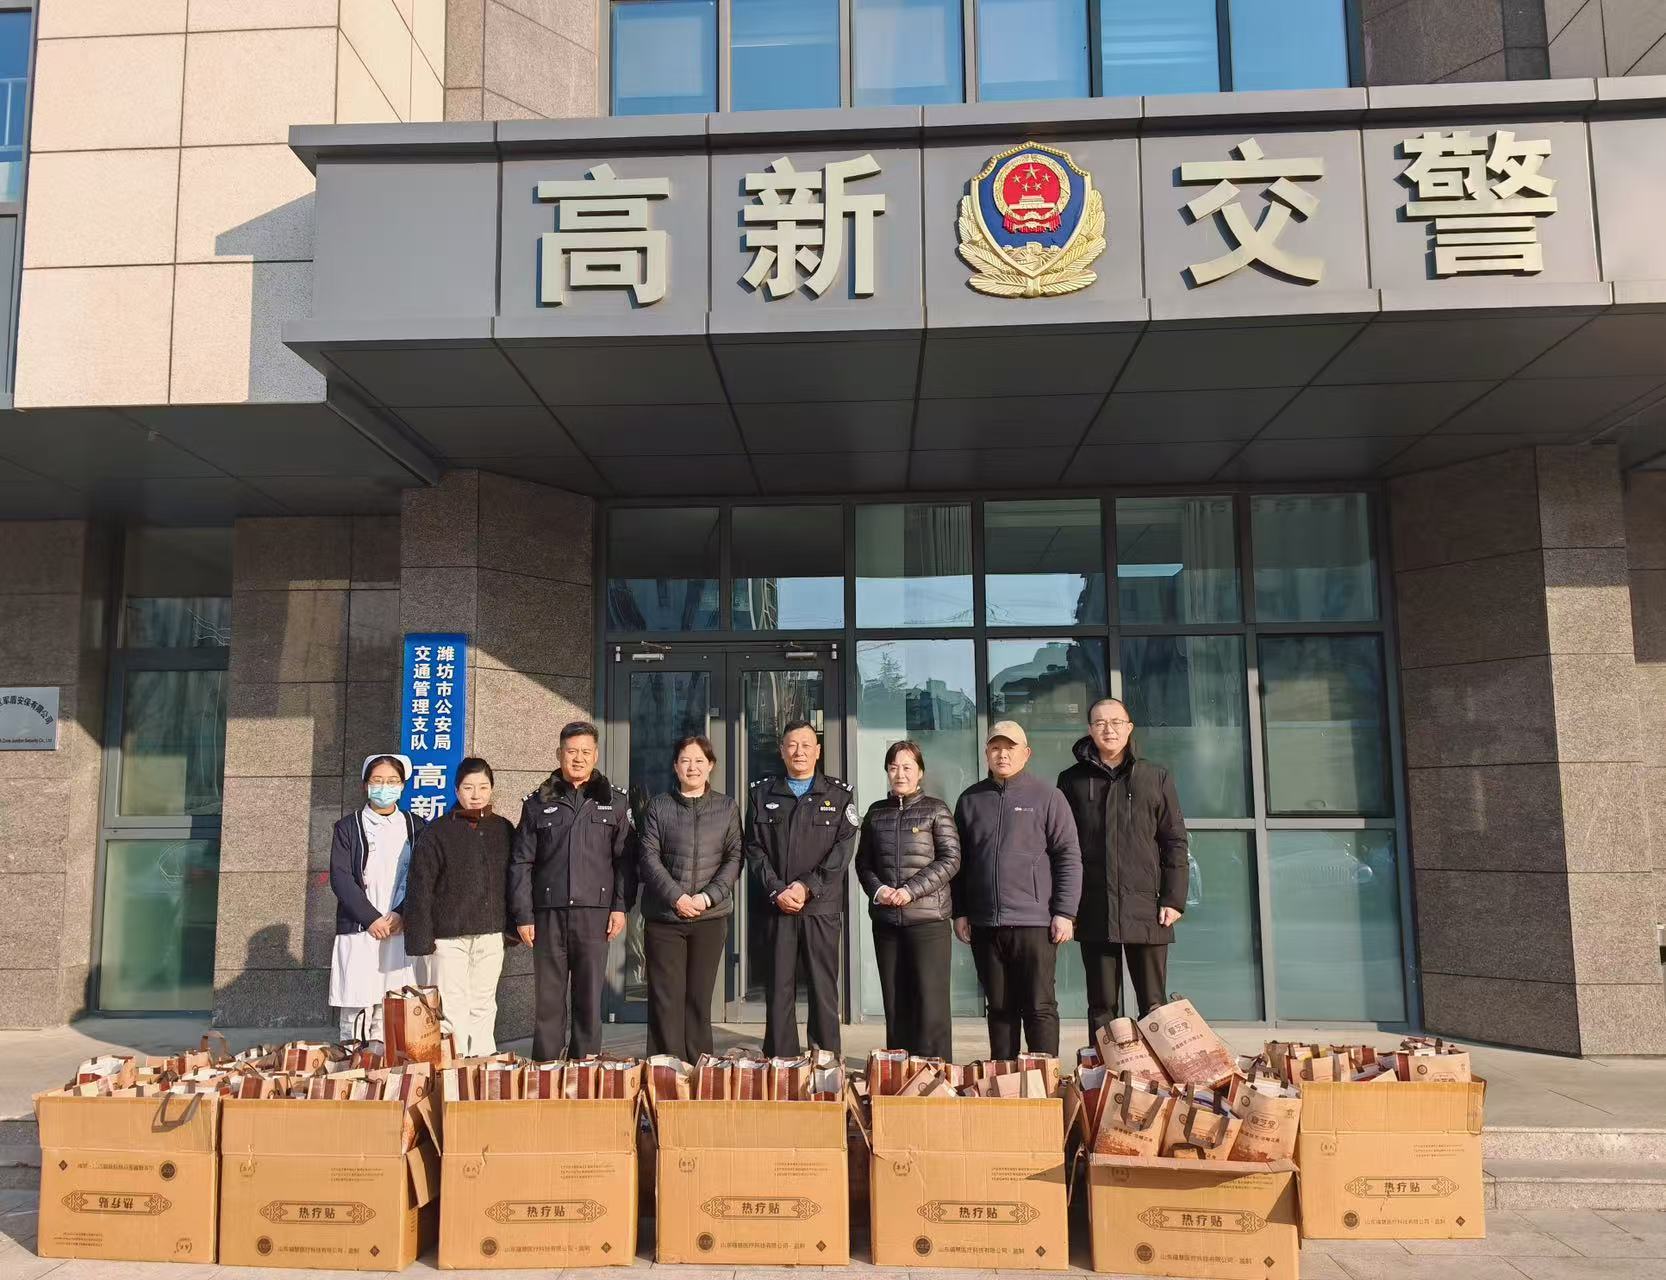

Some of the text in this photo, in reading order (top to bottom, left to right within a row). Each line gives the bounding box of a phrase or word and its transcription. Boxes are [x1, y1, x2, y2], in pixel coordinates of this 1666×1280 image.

[538, 130, 1559, 304] 高新 交警
[410, 645, 432, 751] 交通管理支队
[433, 645, 455, 751] 潍坊市公安局
[411, 762, 447, 821] 高新
[1384, 1181, 1420, 1193] 热疗贴
[299, 1207, 336, 1219] 热疗贴
[527, 1205, 565, 1217] 热疗贴
[742, 1202, 780, 1215] 热疗贴
[959, 1206, 998, 1219] 热疗贴
[1182, 1213, 1223, 1227] 热疗贴
